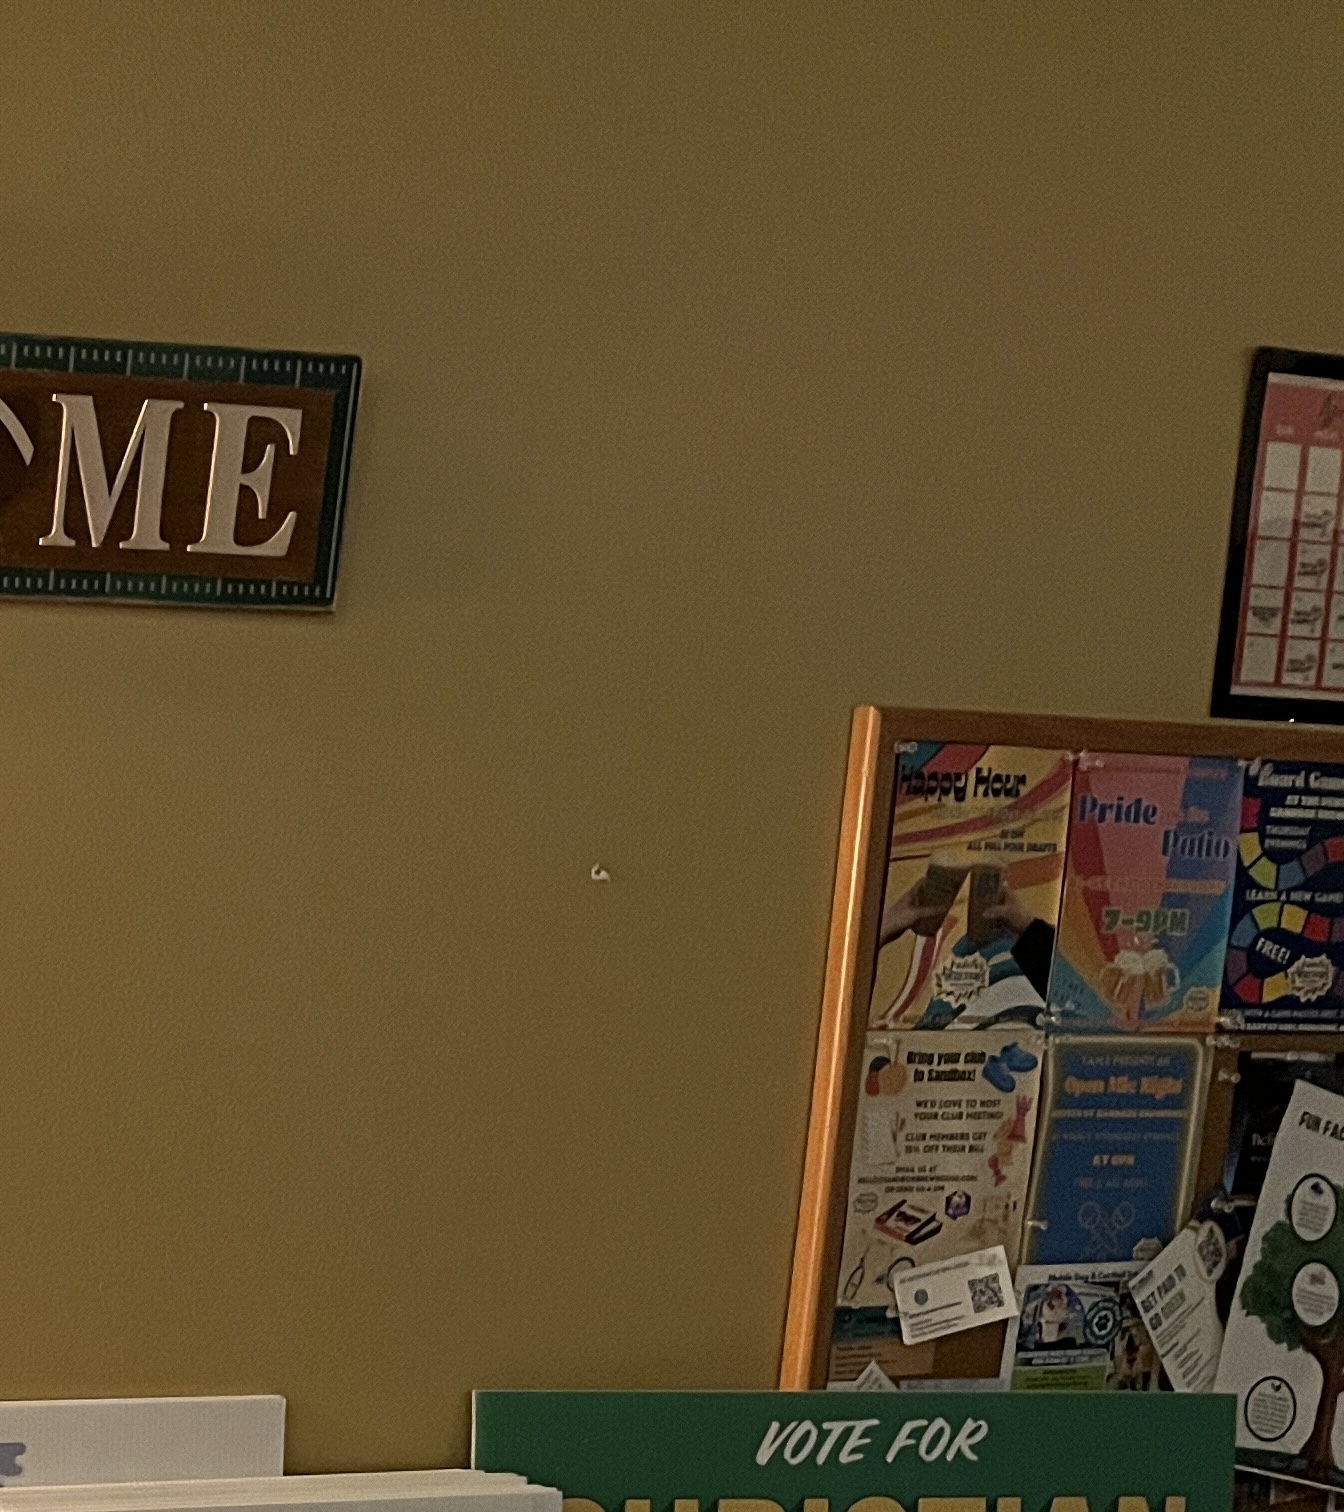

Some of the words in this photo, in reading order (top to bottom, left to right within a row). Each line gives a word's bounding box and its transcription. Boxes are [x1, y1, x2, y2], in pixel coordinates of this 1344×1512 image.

[900, 765, 967, 802] Happy
[974, 767, 1026, 797] Hour
[1079, 796, 1158, 825] Pride
[1162, 829, 1230, 859] Patio
[1102, 908, 1189, 936] 7-9PM
[1255, 937, 1291, 965] FREE!
[937, 1052, 961, 1066] your
[755, 1417, 872, 1466] VOTE
[886, 1418, 989, 1462] FOR
